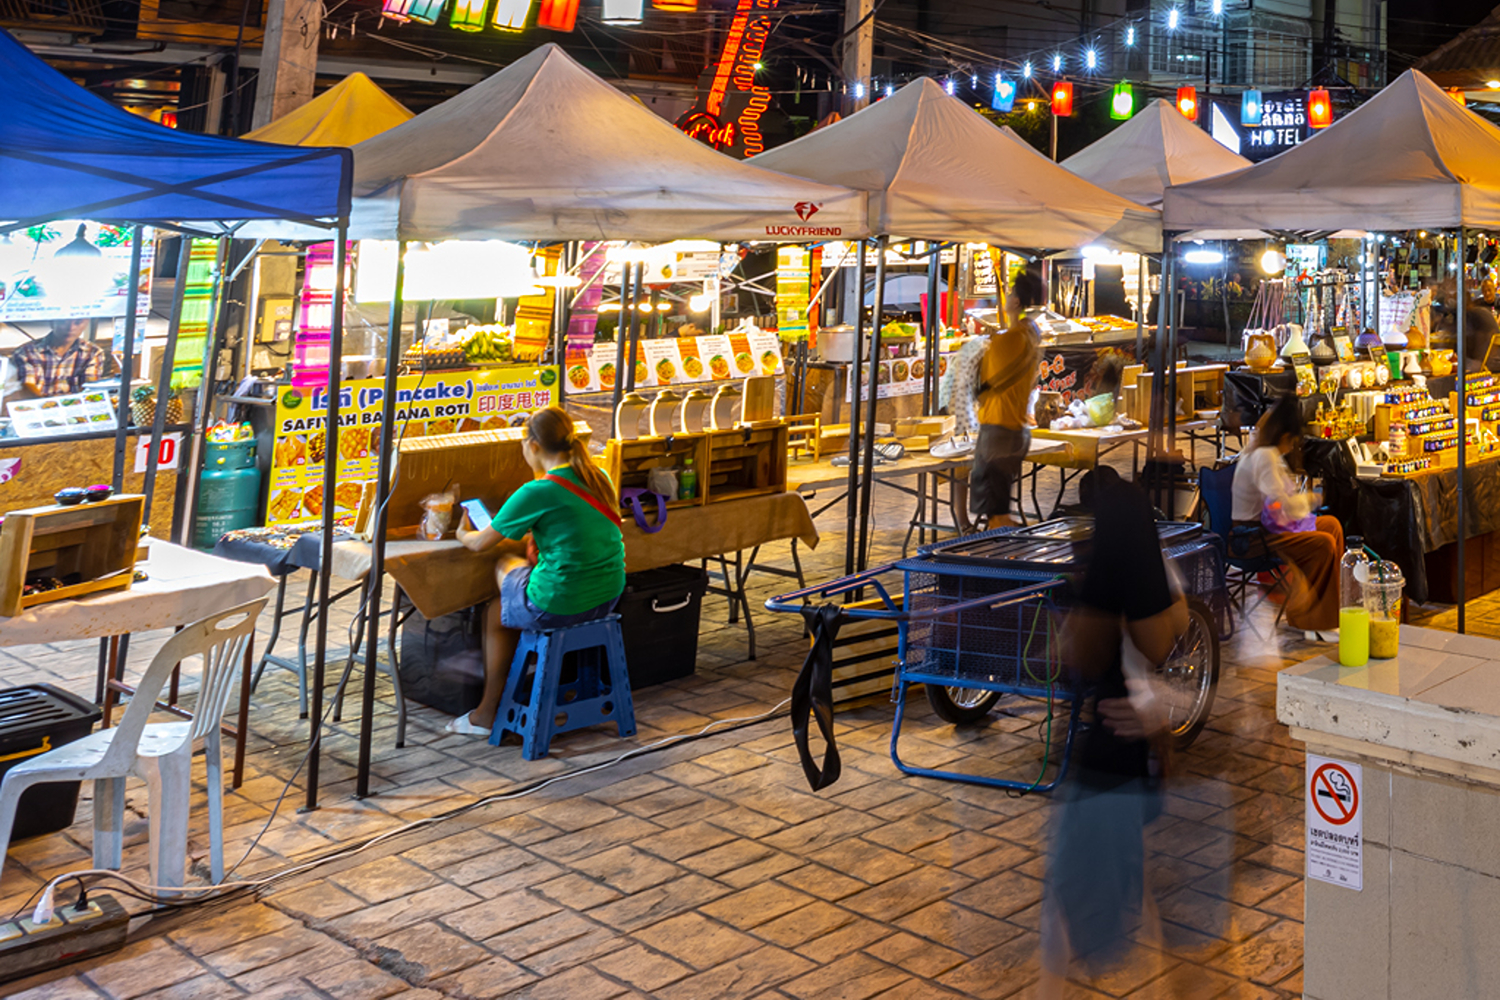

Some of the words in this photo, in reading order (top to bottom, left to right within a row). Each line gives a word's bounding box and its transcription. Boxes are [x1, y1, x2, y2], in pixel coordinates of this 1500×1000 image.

[1251, 128, 1304, 146] HOTEL
[764, 225, 843, 237] LUCKYFRIEND
[357, 379, 474, 410] (Pncake)
[477, 389, 551, 413] 印度甩饼
[361, 407, 430, 425] BAANA
[434, 403, 470, 418] ROTI
